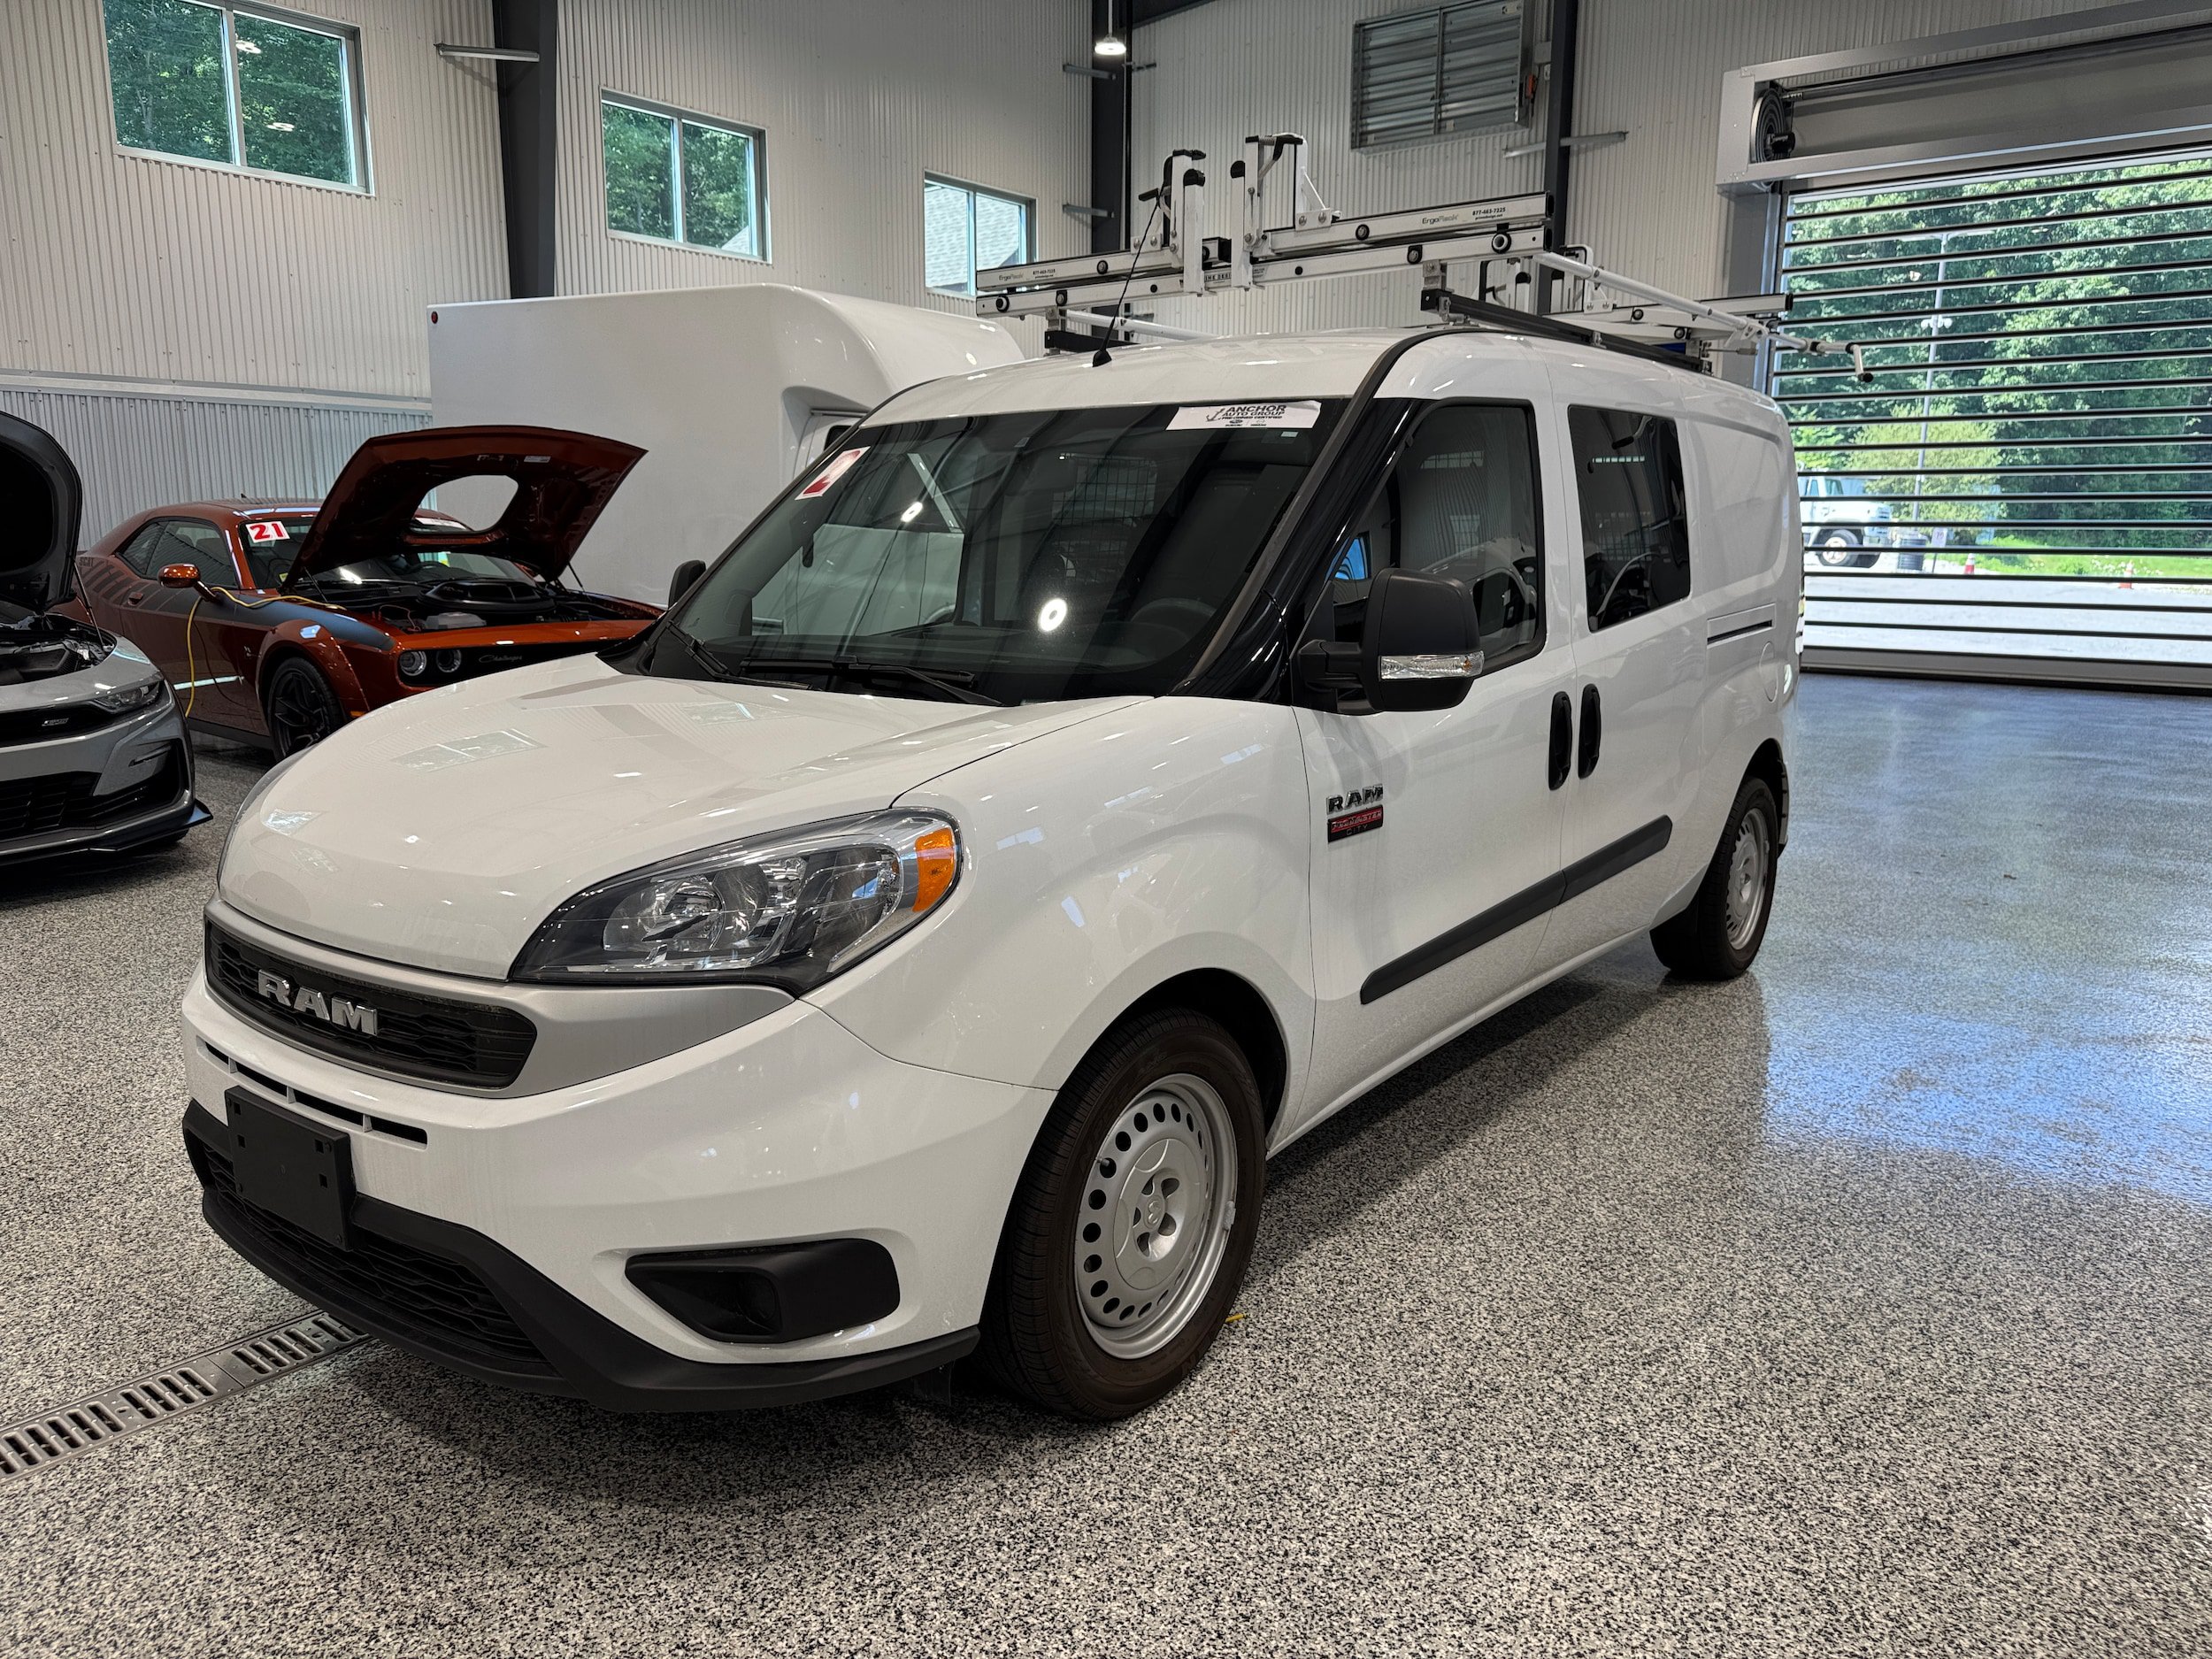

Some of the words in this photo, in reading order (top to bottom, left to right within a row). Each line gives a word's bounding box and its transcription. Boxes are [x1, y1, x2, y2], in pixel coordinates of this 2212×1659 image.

[250, 523, 284, 541] 21
[1326, 783, 1384, 815] RAM
[1346, 824, 1368, 835] CITY
[257, 969, 378, 1036] RAM
